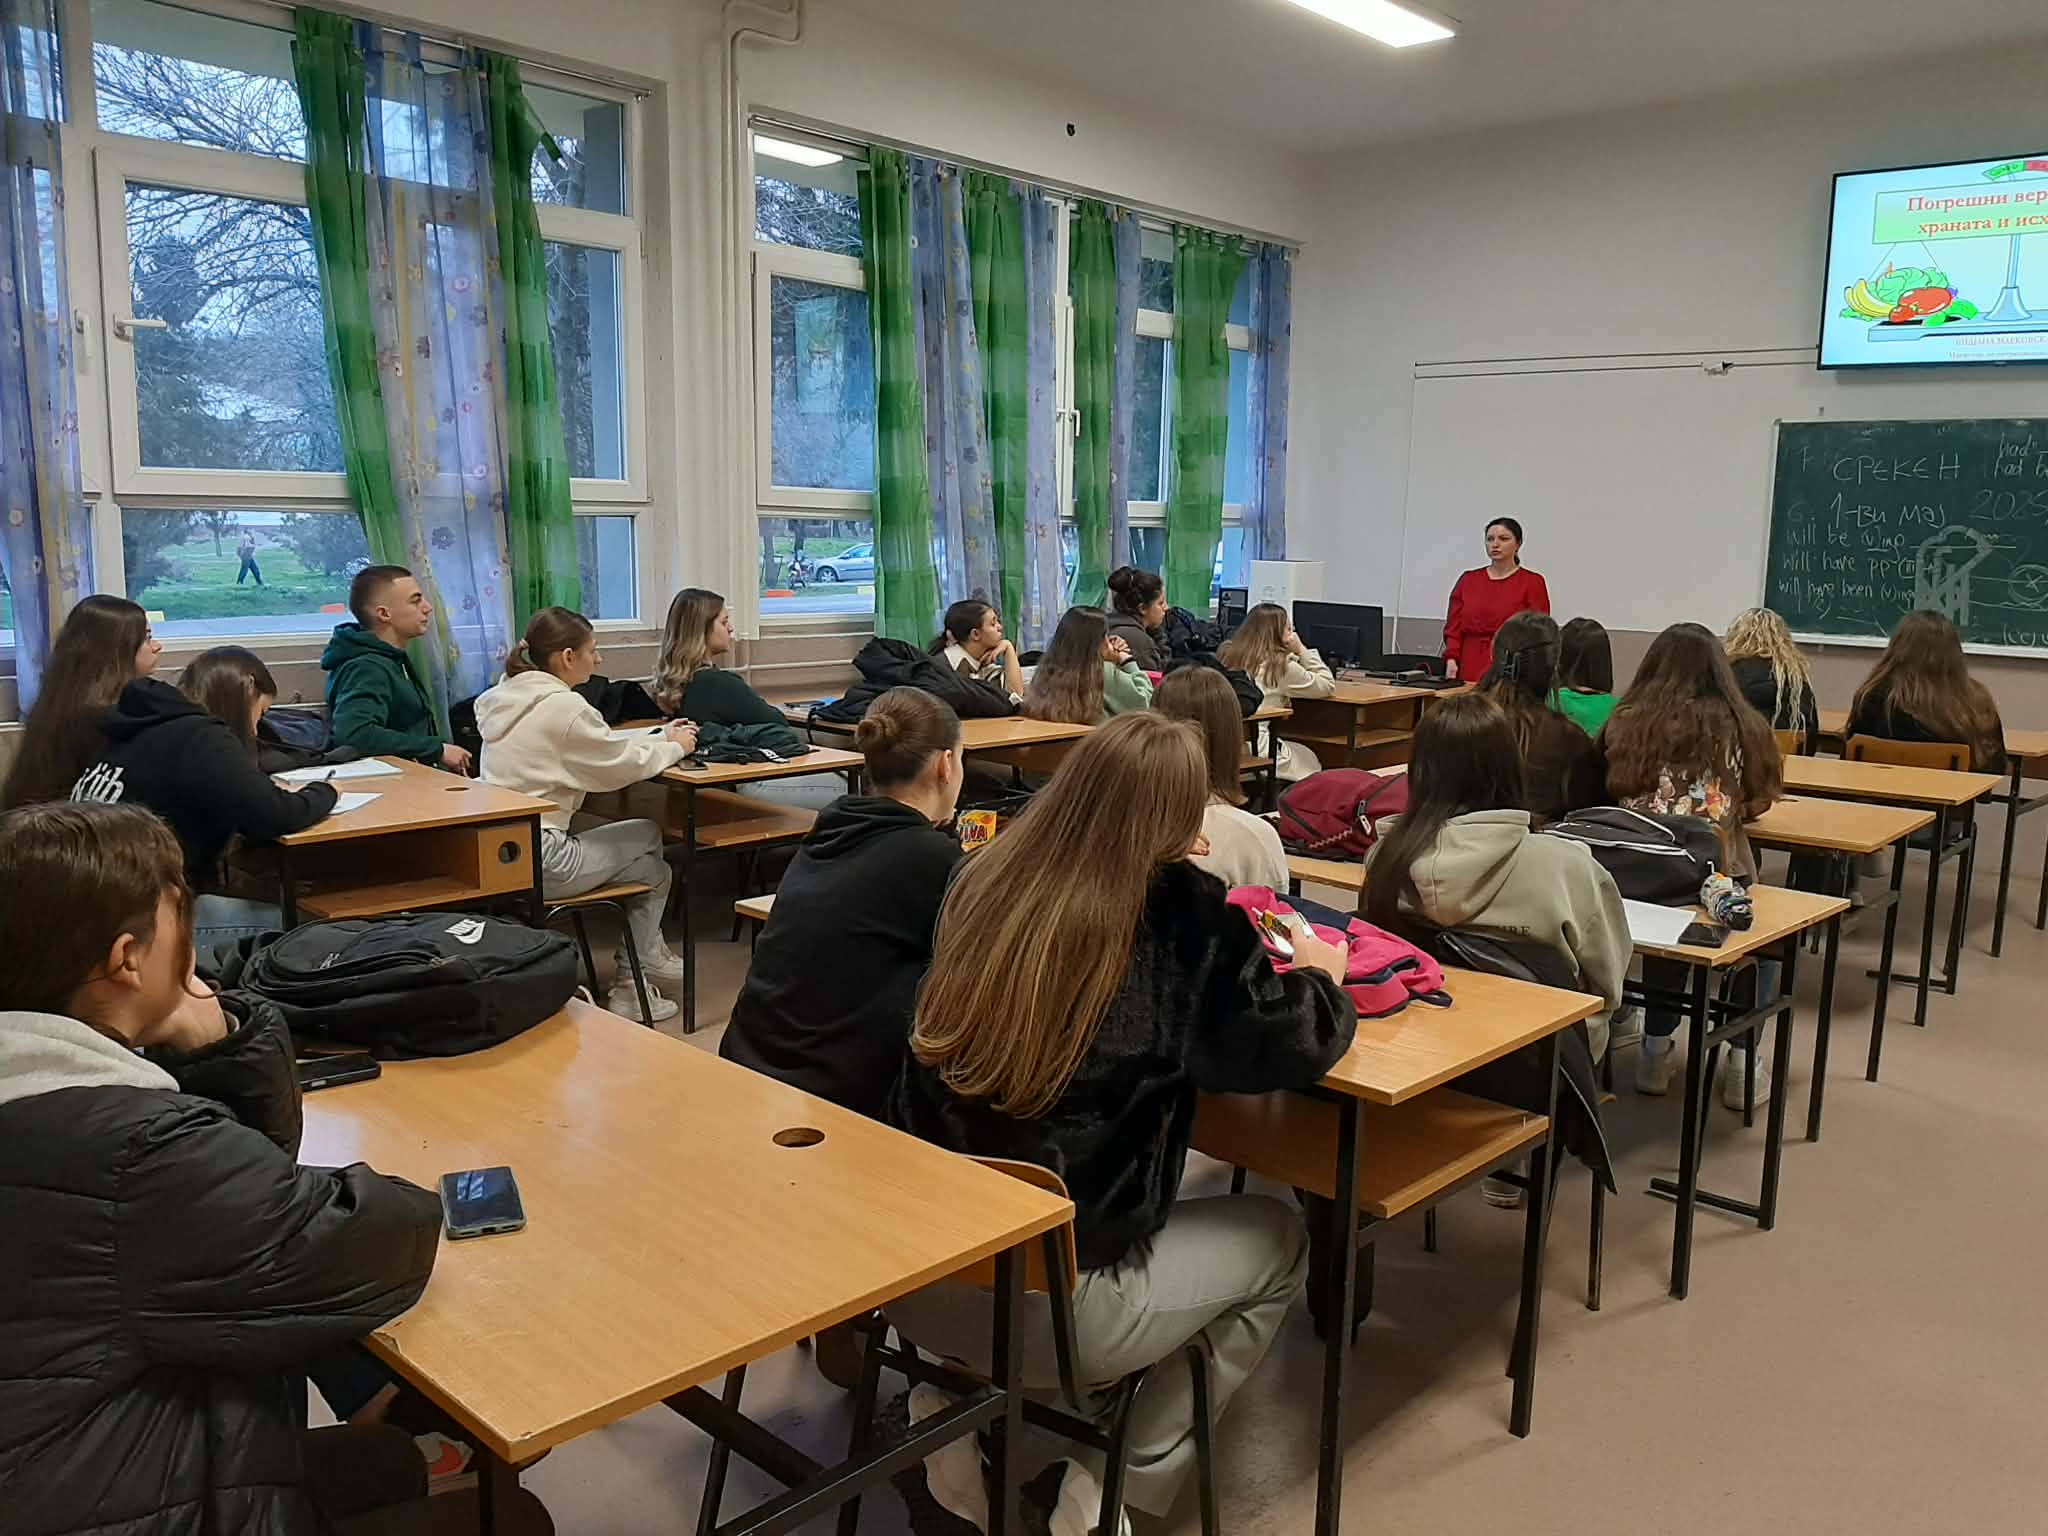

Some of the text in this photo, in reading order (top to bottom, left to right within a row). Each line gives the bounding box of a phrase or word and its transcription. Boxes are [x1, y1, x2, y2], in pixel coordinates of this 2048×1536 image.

[1908, 194, 2007, 213] Погрешни
[1918, 219, 1991, 237] храната
[1998, 217, 2010, 228] и
[1827, 524, 1852, 547] be
[1783, 550, 1811, 572] will
[1822, 551, 1856, 572] have
